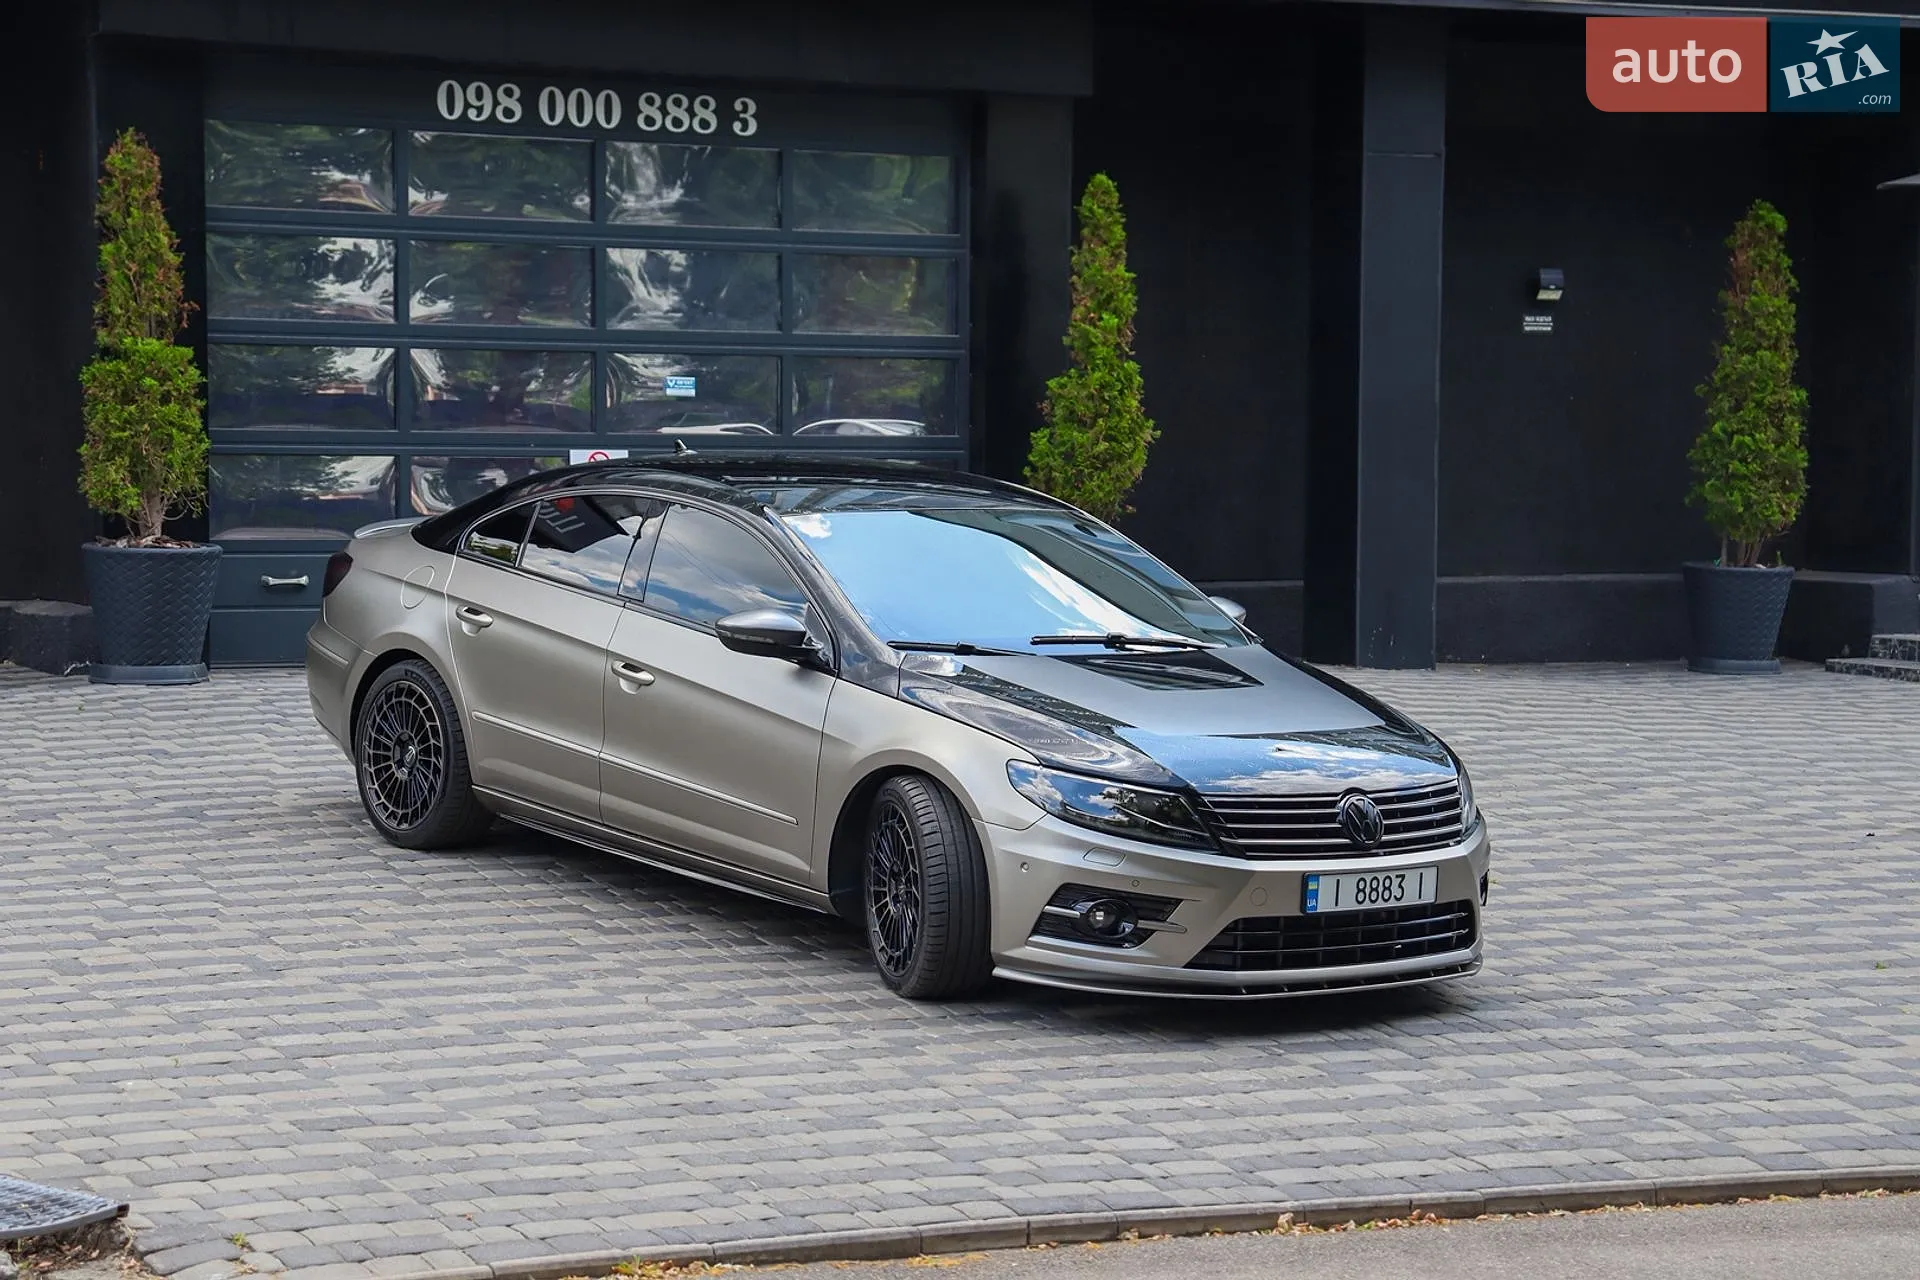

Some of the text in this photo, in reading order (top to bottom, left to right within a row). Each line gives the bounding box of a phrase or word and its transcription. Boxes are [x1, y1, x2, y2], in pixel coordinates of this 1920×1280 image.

[436, 80, 758, 136] 098 000 888 3
[1306, 898, 1317, 908] UA
[1355, 873, 1406, 905] 8883
